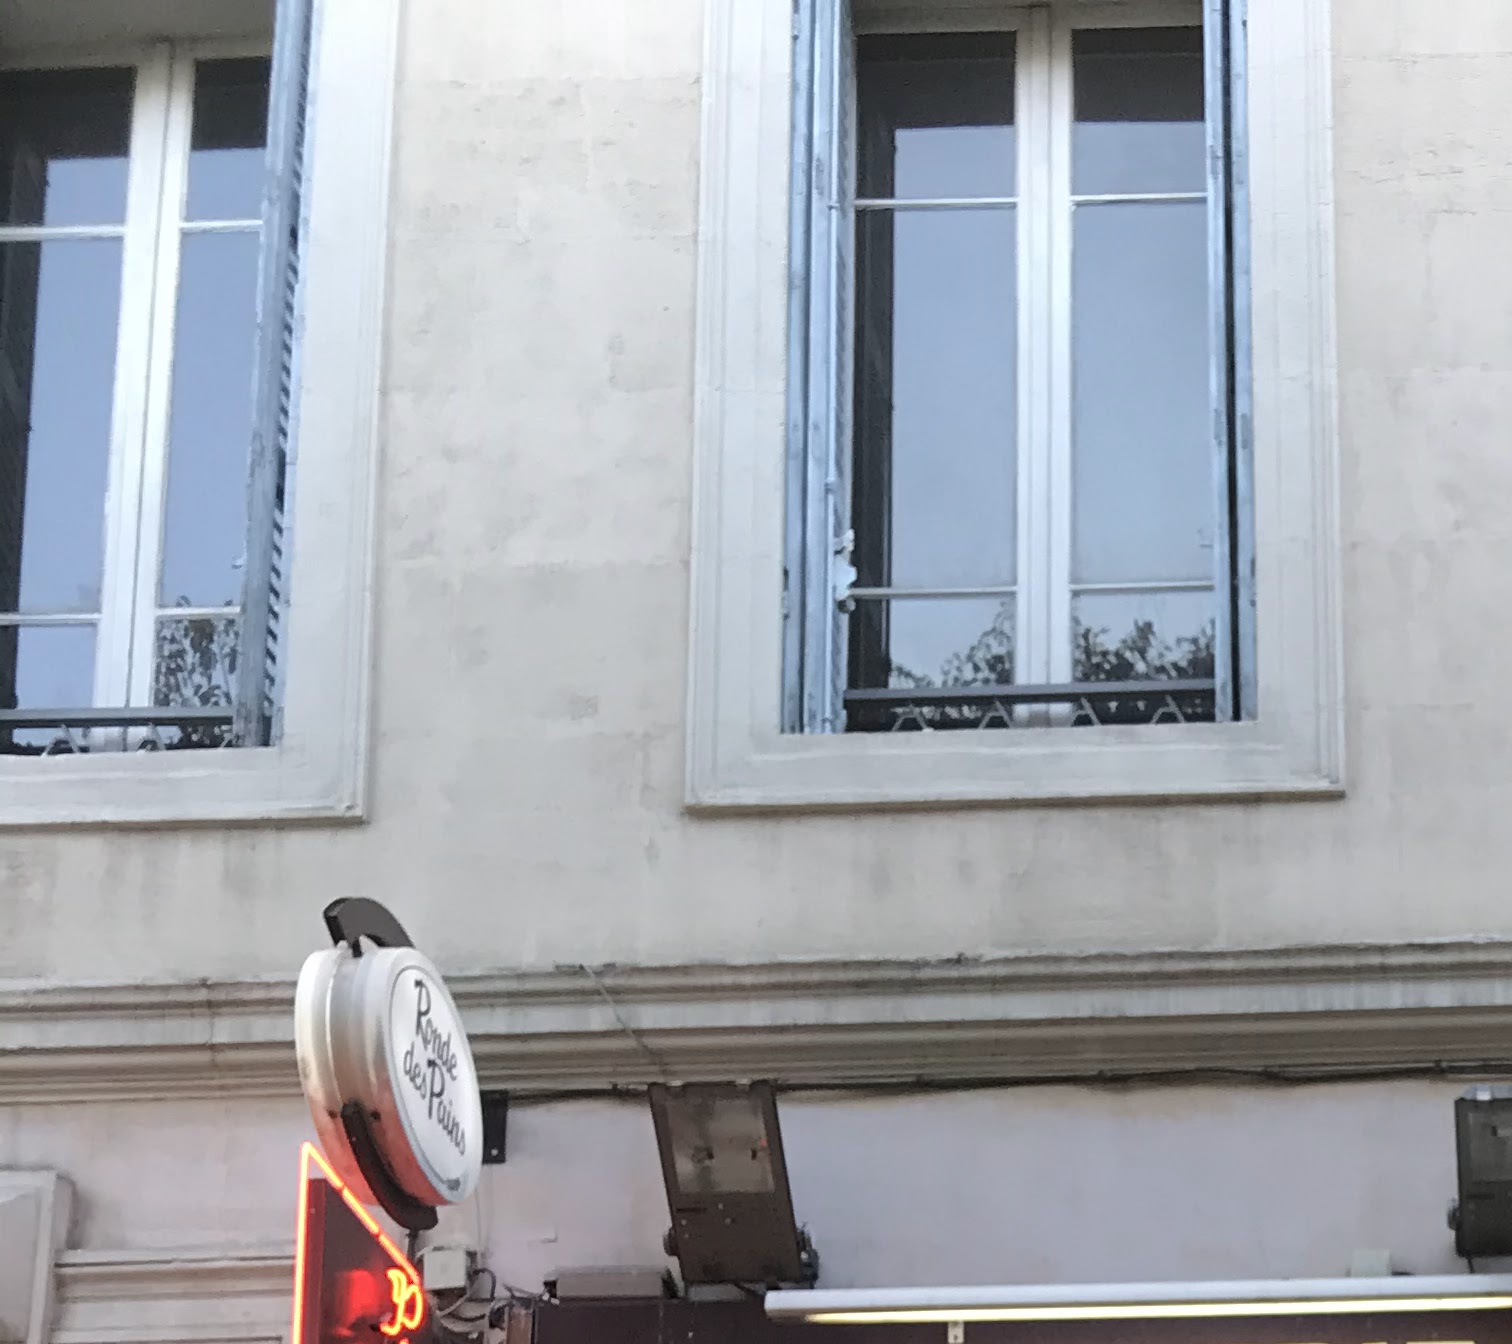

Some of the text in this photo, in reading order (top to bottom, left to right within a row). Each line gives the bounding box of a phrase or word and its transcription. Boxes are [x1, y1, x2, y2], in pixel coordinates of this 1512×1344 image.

[414, 979, 458, 1082] Ronde
[403, 1041, 466, 1157] des Pains
